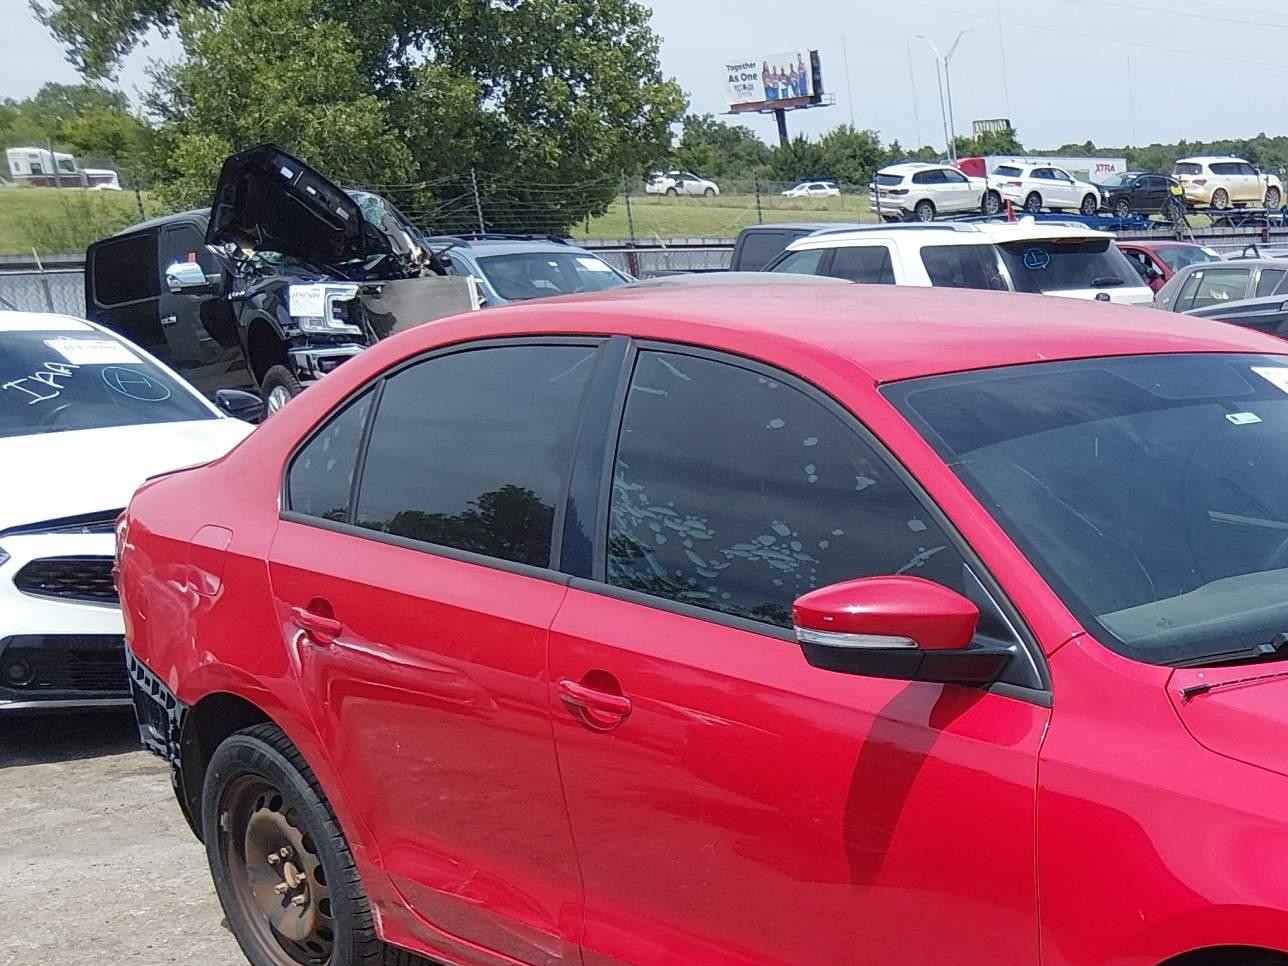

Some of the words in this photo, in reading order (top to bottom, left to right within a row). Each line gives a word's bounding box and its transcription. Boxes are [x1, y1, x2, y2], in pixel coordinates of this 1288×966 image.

[726, 62, 757, 73] Together
[728, 75, 740, 83] As
[741, 73, 758, 81] One
[1095, 163, 1116, 174] XTRA
[2, 362, 81, 405] IAA
